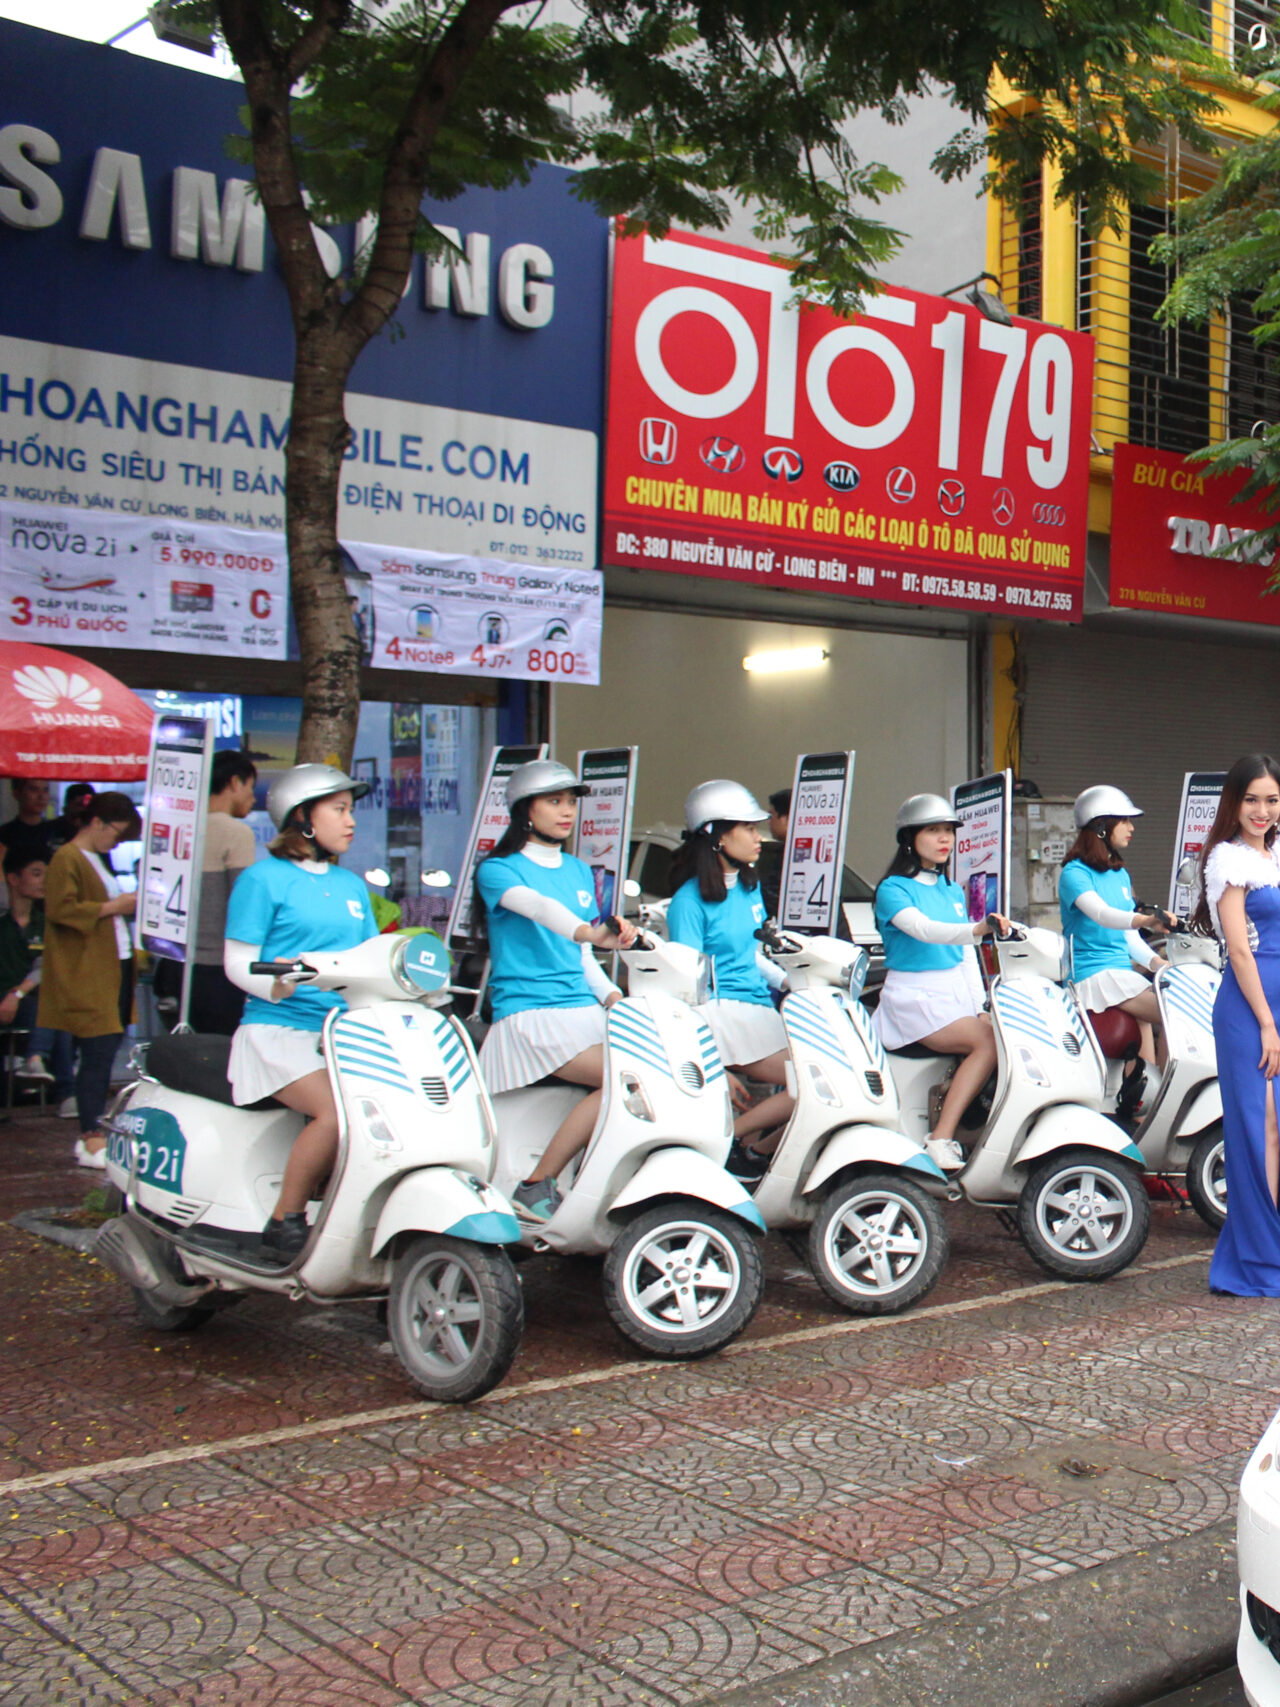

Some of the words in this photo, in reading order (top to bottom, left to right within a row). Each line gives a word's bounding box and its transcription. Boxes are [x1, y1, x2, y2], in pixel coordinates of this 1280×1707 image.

[0, 124, 554, 330] SAMNG
[0, 373, 529, 485] HOANGHAMBILE.COM
[829, 467, 856, 486] KIA
[1133, 460, 1167, 487] BÙI
[102, 450, 165, 482] SIÊU
[179, 463, 222, 496] THỊ
[233, 466, 287, 496] BÁN
[344, 482, 402, 515] ĐIỆN
[413, 493, 484, 527] THOẠI
[494, 504, 514, 525] DI
[523, 505, 586, 535] ĐỘNG
[149, 502, 188, 518] LONG
[626, 476, 698, 513] CHUYÊN
[703, 488, 742, 520] MUA
[747, 492, 782, 526] BÁN
[787, 498, 809, 530] KÝ
[812, 497, 840, 535] GỬI
[844, 508, 876, 541] CÁC
[880, 517, 914, 551] LOẠI
[918, 518, 929, 549] Ô
[933, 522, 950, 552] TÔ
[954, 526, 975, 556] ĐÃ
[978, 532, 1007, 560] QUA
[1010, 529, 1031, 563] SỬ
[1033, 541, 1070, 571] DỤNG
[12, 518, 68, 531] HUAWEI
[12, 529, 87, 554] nova
[95, 537, 116, 557] 2i
[161, 546, 274, 573] 5.990.000Đ
[616, 532, 640, 555] ĐC:
[643, 536, 668, 559] 380
[671, 537, 724, 567] NGUYỄN
[727, 545, 753, 570] VĂN
[755, 548, 775, 573] CỪ
[784, 556, 816, 579] LONG
[819, 558, 848, 583] BIÊN
[857, 566, 875, 586] HN
[902, 572, 920, 592] ĐT:
[922, 577, 997, 602] 0975.58.58.59
[1005, 586, 1072, 611] 0978.297.555
[415, 565, 477, 584] Samsung
[518, 576, 561, 594] Galaxy
[564, 581, 600, 597] Note8
[10, 596, 33, 626] 3
[37, 612, 70, 629] PHÚ
[76, 615, 128, 632] QUỐC
[386, 636, 402, 661] 4
[405, 647, 456, 666] Note8
[471, 644, 486, 668] 4
[528, 649, 576, 675] 800
[32, 711, 121, 729] HUAWEI
[799, 793, 827, 809] nova
[974, 804, 1000, 818] HUAWEI
[1187, 807, 1215, 819] nova
[958, 839, 971, 854] 03
[807, 874, 828, 907] 4
[154, 1146, 180, 1182] 2i
